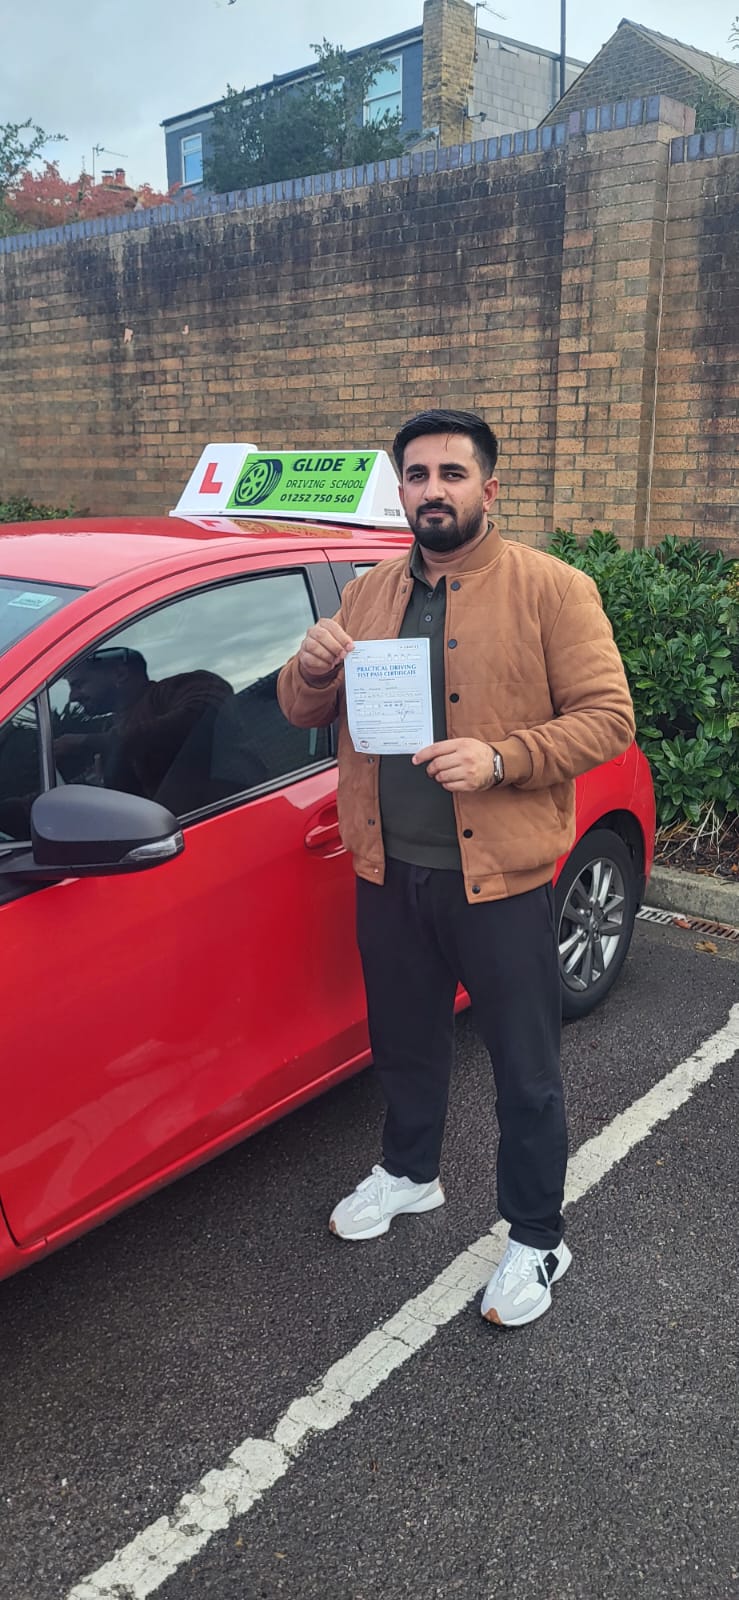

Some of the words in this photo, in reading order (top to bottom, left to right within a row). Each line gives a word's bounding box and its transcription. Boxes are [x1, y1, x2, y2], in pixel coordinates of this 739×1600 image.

[293, 458, 345, 472] GLIDE
[353, 457, 371, 472] X
[199, 462, 223, 494] L
[286, 479, 325, 489] DRIVING
[330, 479, 364, 489] SCHOOL
[280, 494, 312, 502] 01252
[312, 494, 333, 503] 750
[333, 494, 354, 503] 560
